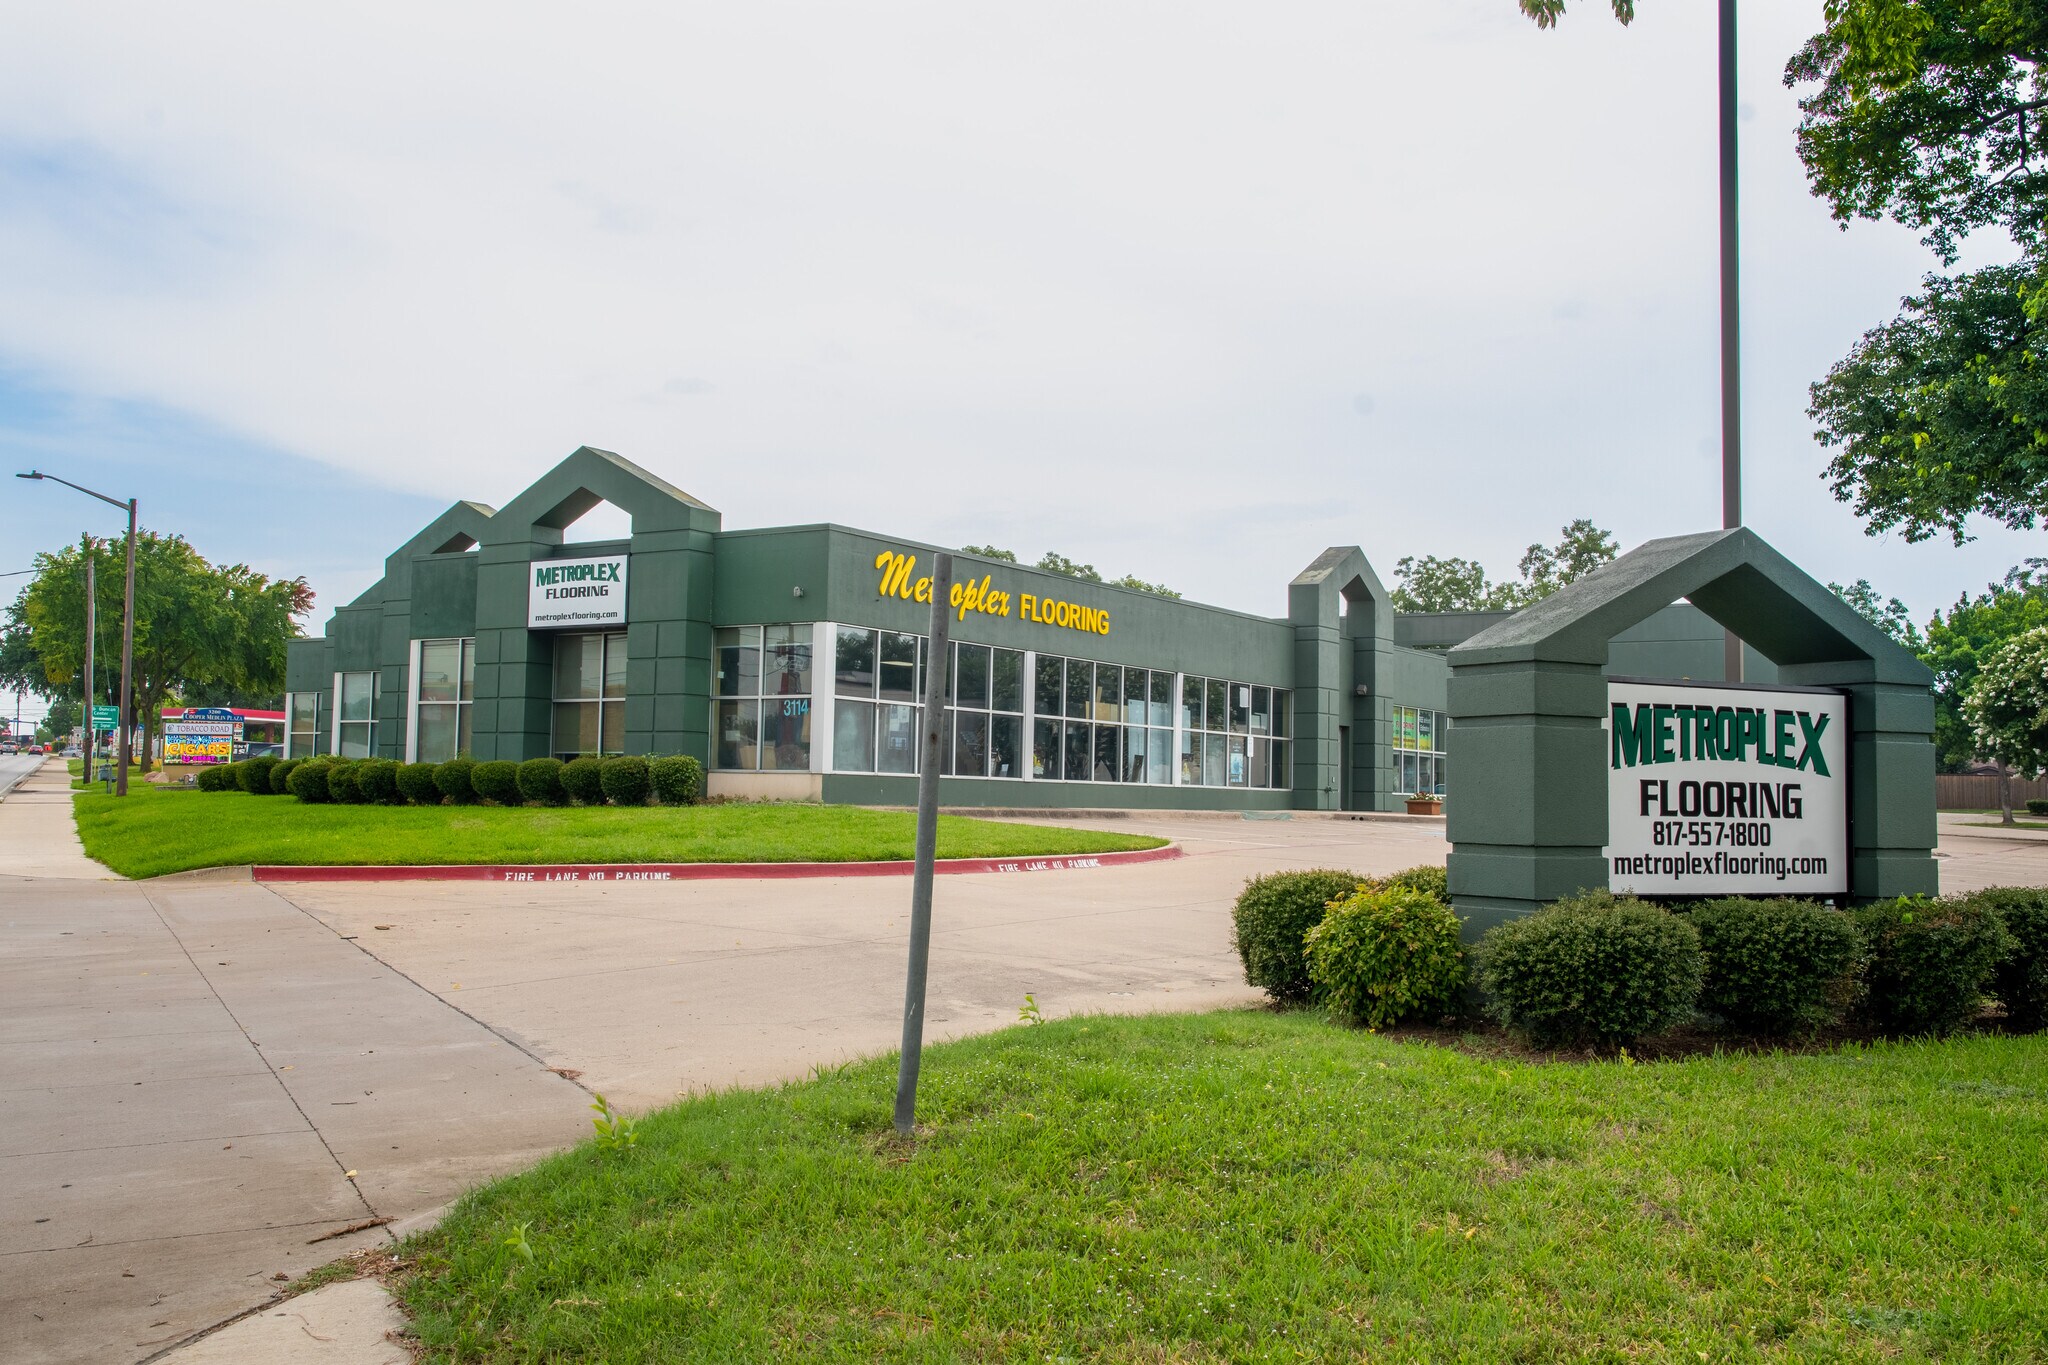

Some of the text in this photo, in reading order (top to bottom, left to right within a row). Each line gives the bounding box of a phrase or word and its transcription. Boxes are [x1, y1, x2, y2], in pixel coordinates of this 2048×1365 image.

[536, 563, 621, 587] METROPLEX
[546, 585, 609, 600] FLOORING
[875, 551, 1110, 635] Meoplex FLOORING
[535, 611, 618, 622] metroplexflooring.com
[784, 700, 808, 716] 3114
[177, 725, 209, 733] TOBACCO
[210, 725, 230, 733] ROAD
[1611, 702, 1831, 778] METROPLEX
[168, 743, 228, 755] CIGARS
[1640, 779, 1803, 819] FLOORING
[1653, 821, 1771, 846] 817-557-1800
[997, 858, 1101, 873] FIRE LANE NO PARKING
[1614, 851, 1828, 880] metroplexflooring.com
[504, 871, 672, 881] FIRE LANE NO PARKING
